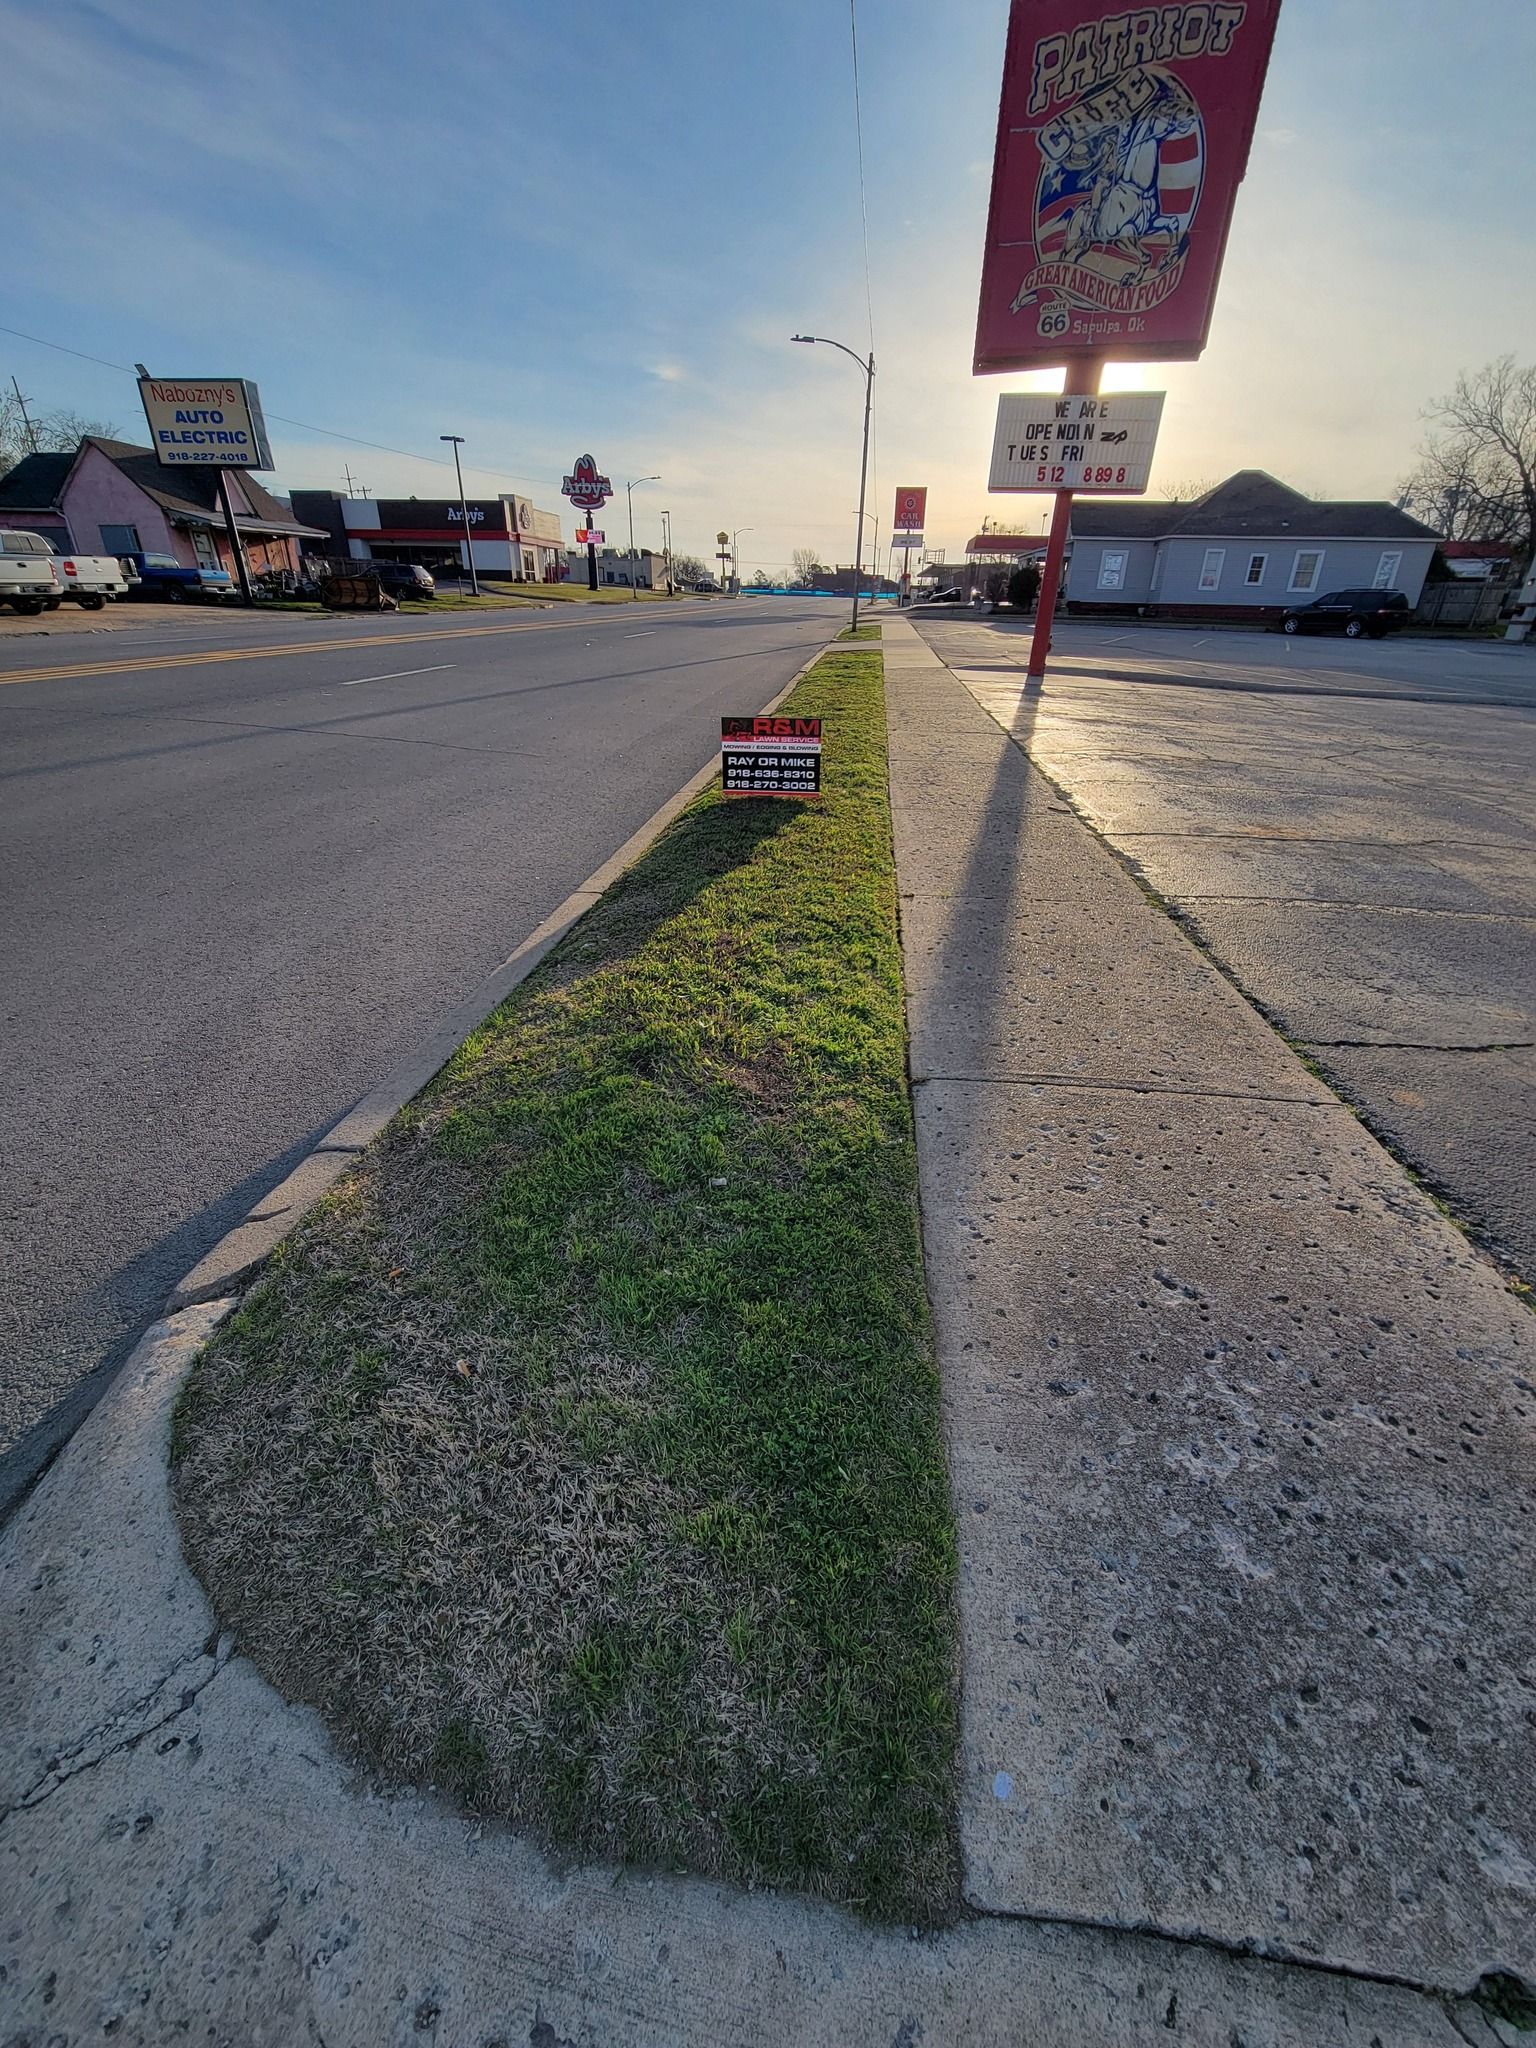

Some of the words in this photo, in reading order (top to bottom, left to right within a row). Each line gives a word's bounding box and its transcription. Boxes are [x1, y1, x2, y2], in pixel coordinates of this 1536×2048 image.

[1028, 4, 1245, 115] PATRIOT
[1038, 66, 1156, 160] CAFE
[1025, 265, 1070, 290] GREAT
[1071, 271, 1135, 310] AMERICAN
[1134, 266, 1179, 310] FOOD
[1042, 302, 1067, 311] ROUTE
[1041, 314, 1066, 333] 66
[151, 383, 235, 407] Nabozny's
[175, 410, 224, 424] AUTO
[1055, 402, 1071, 418] WE
[1079, 401, 1109, 418] ARE
[158, 430, 248, 444] ELECTRIC
[168, 452, 248, 461] 918-227-4018
[1008, 445, 1049, 461] TUES
[1061, 445, 1084, 461] FRI
[1037, 466, 1065, 482] 512
[562, 476, 610, 498] Arby's
[897, 520, 921, 528] WASH
[753, 717, 820, 735] R&M
[728, 757, 755, 765] RAY
[758, 757, 778, 766] OR
[781, 758, 815, 767] MIKE
[728, 769, 815, 779] 918-636-8310
[727, 780, 816, 790] 918-270-3002
